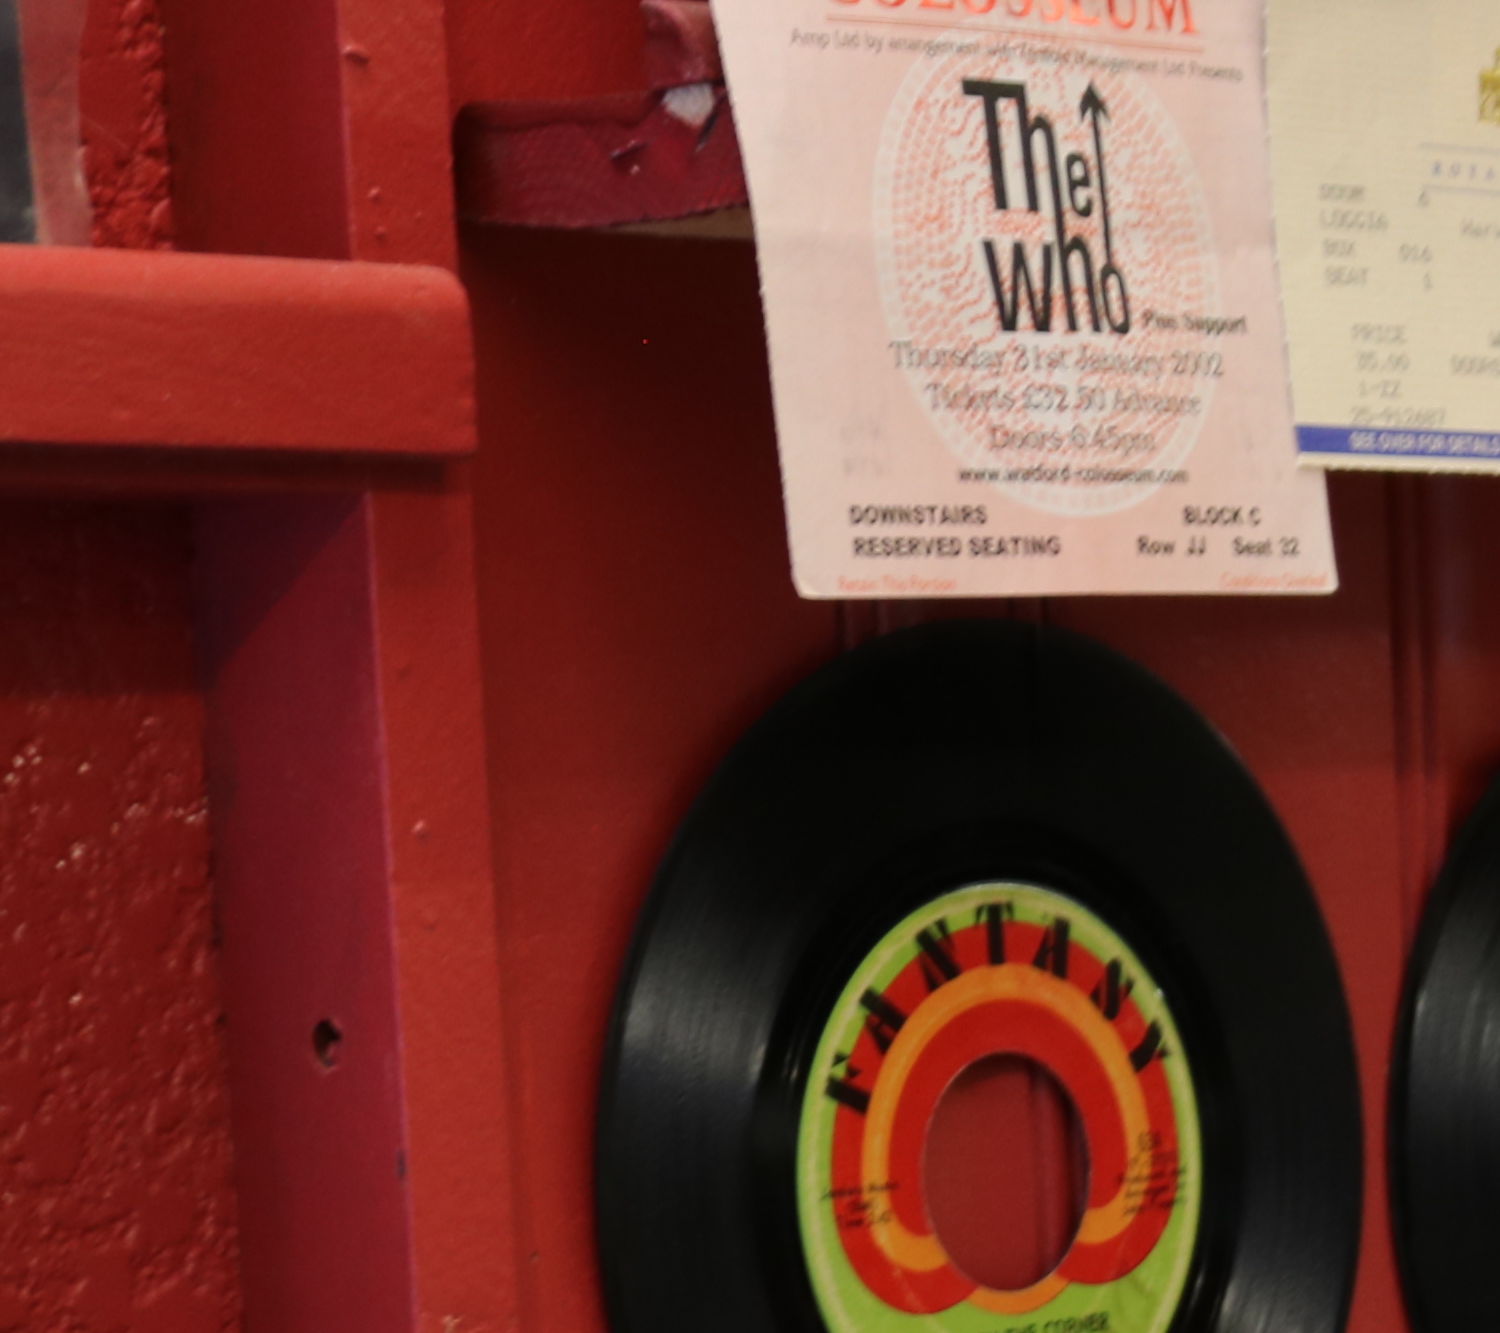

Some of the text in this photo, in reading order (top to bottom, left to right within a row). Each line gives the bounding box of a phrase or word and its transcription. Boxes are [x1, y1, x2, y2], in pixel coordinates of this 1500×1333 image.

[888, 339, 1004, 377] Thursday
[1171, 351, 1223, 378] 2002
[848, 504, 1262, 527] DOWNSTAIRS BLOCK C
[852, 536, 962, 559] RESERVED
[967, 536, 1062, 559] SEATING
[1137, 536, 1175, 557] Row
[1230, 536, 1272, 557] Seat
[824, 899, 1172, 1115] FANTASY
